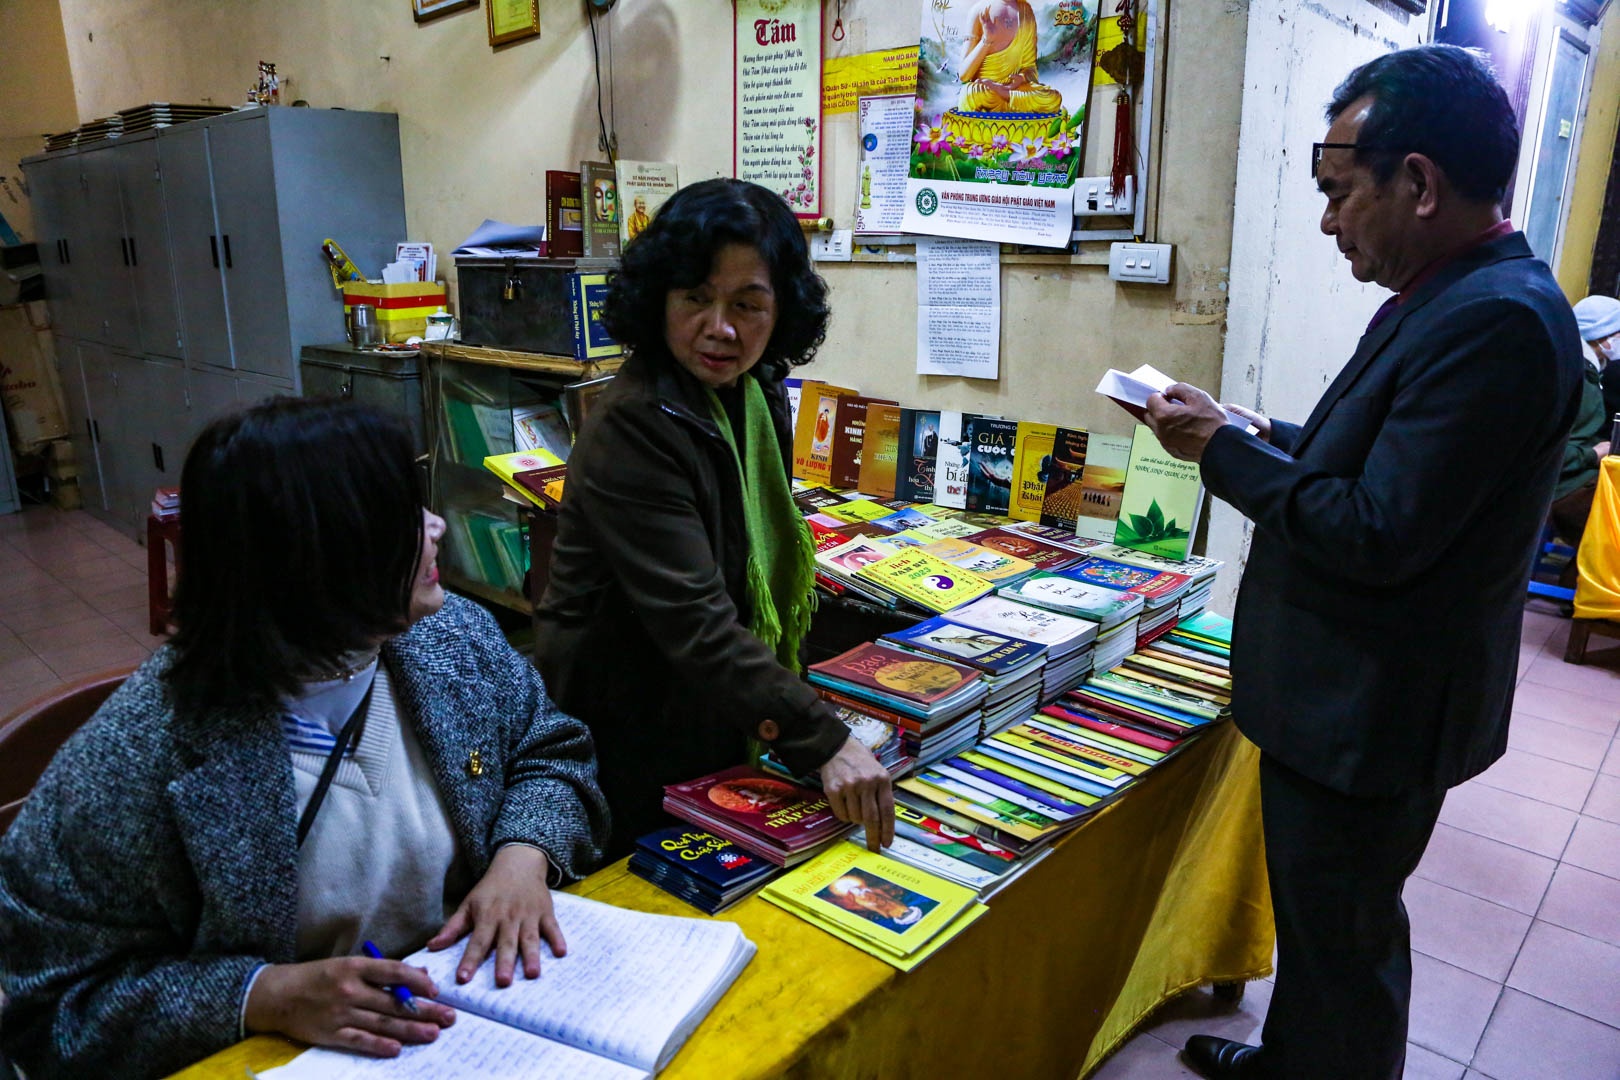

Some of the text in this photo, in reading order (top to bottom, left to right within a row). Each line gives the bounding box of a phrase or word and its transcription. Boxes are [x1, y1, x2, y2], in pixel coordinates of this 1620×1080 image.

[754, 18, 796, 46] Tâm
[965, 194, 978, 202] TRUNG
[991, 194, 1002, 204] GIÁO
[1010, 196, 1022, 207] PHẬT
[1022, 196, 1032, 206] GIÁO
[1034, 198, 1044, 208] VIỆT
[1044, 200, 1056, 208] NAM
[845, 426, 862, 436] KINH
[978, 431, 1004, 446] GIÁ
[811, 454, 828, 462] KINH
[806, 460, 826, 470] LƯỢNG
[946, 467, 958, 482] bí
[1024, 480, 1044, 492] Phật
[889, 559, 911, 570] lịch
[908, 567, 932, 580] 2023
[842, 654, 886, 671] Đạo
[764, 810, 803, 829] THẬP
